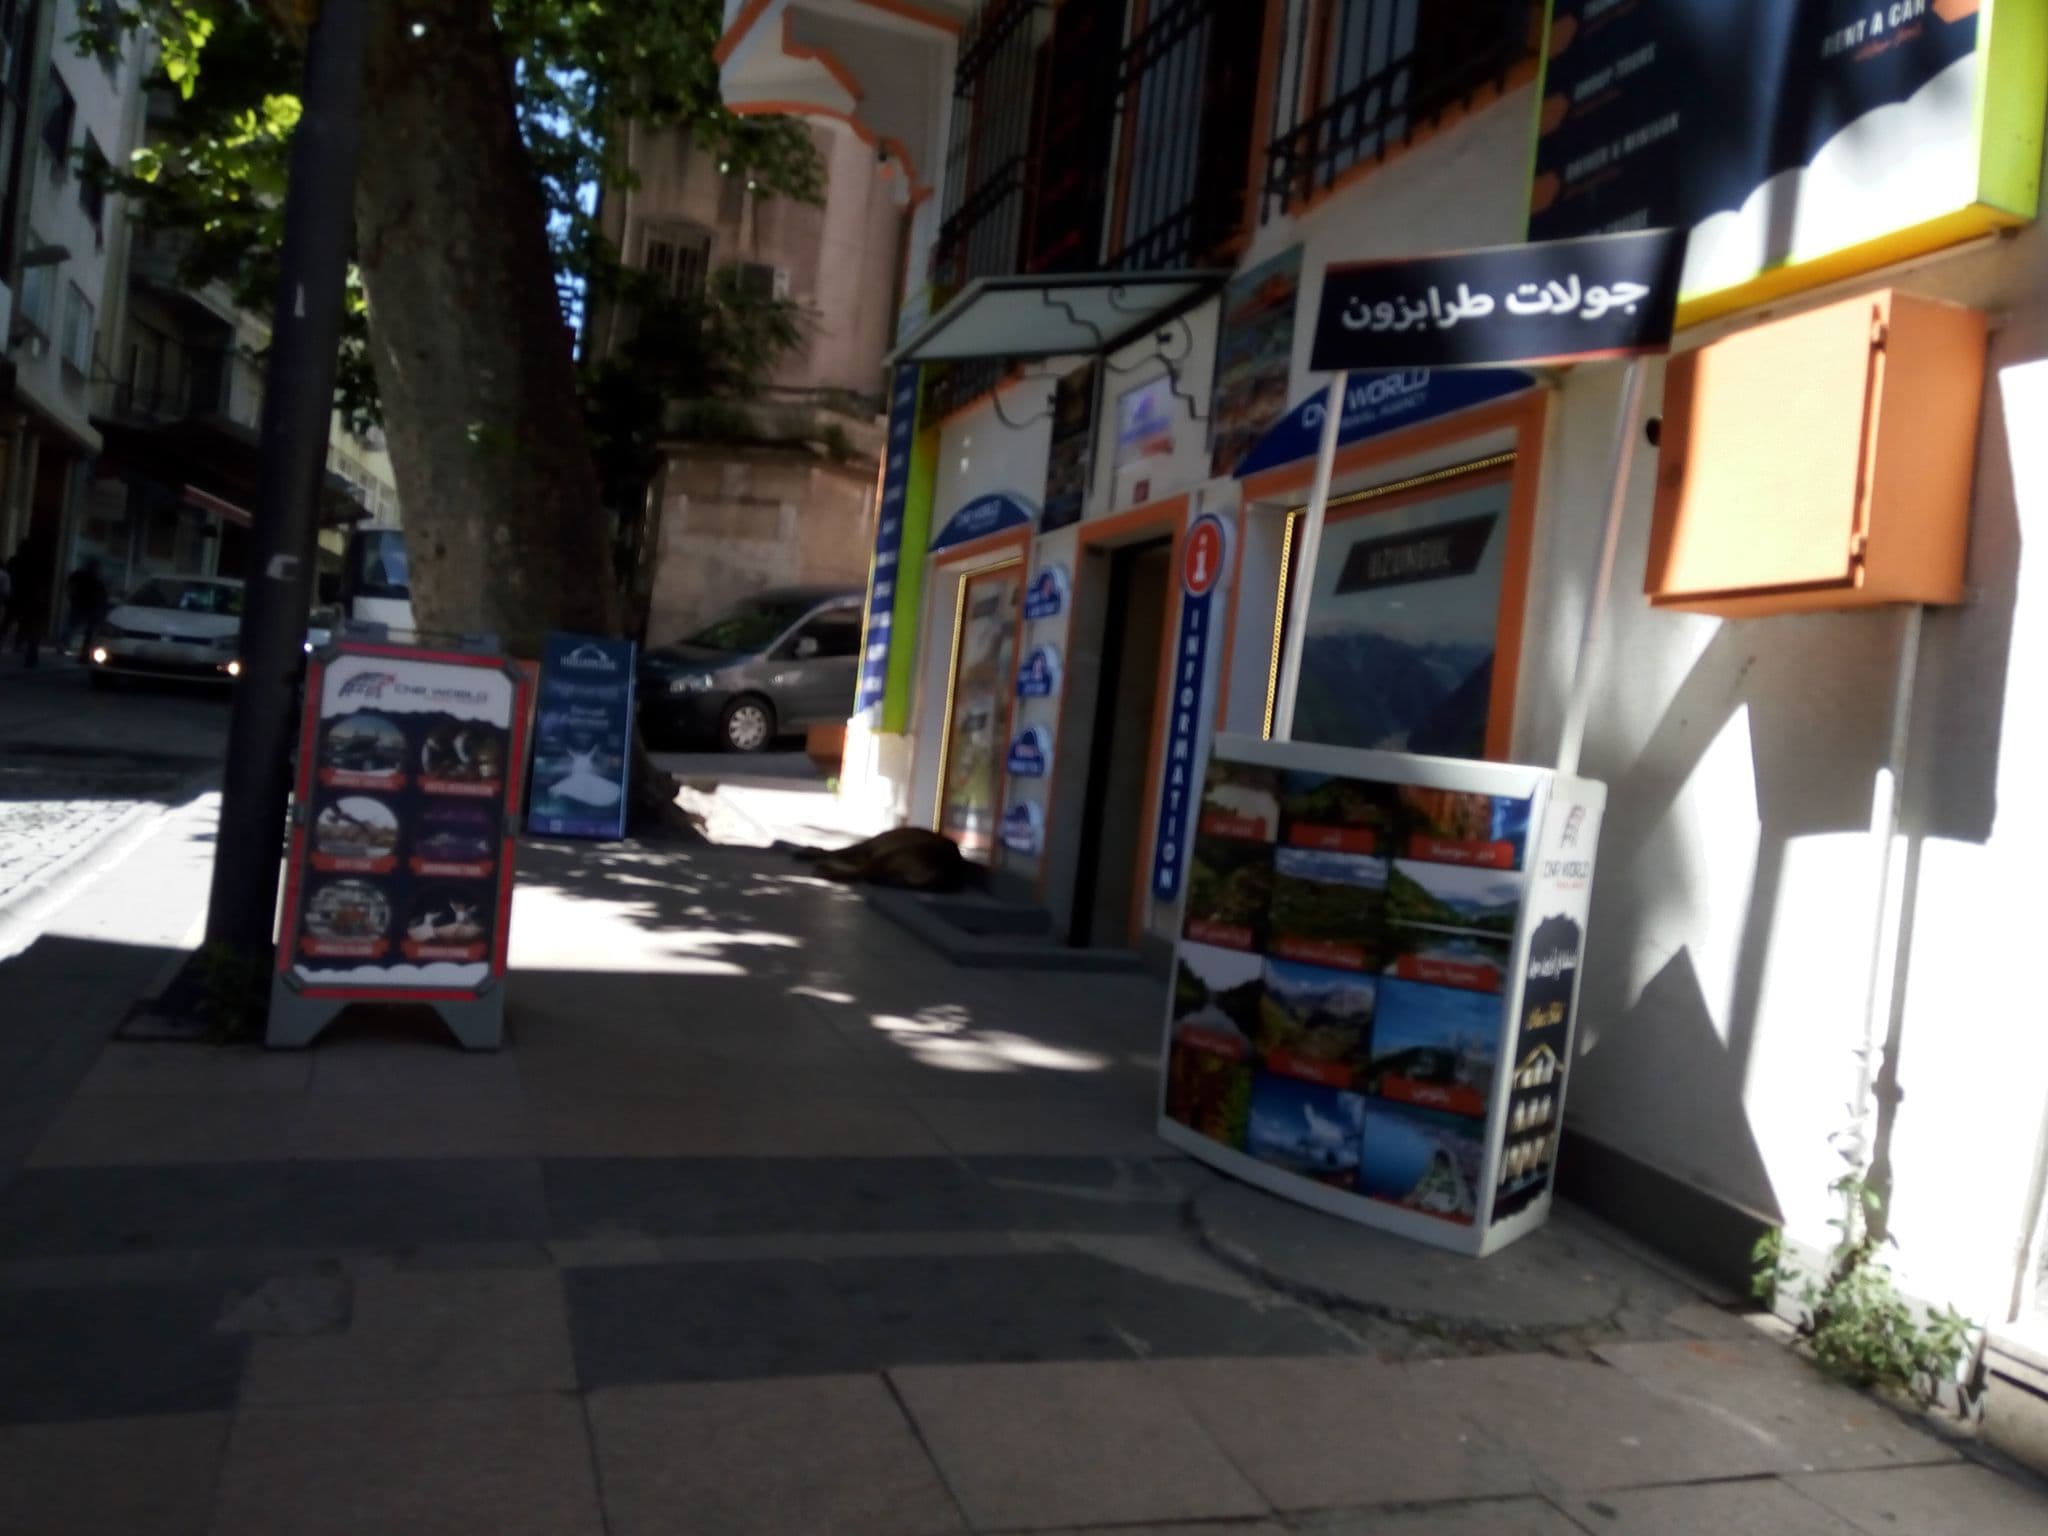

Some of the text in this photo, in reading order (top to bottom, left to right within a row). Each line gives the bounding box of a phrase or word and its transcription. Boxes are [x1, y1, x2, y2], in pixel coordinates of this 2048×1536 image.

[1821, 18, 1867, 57] RENT
[1869, 11, 1884, 36] A
[1887, 0, 1927, 28] CAR
[1341, 273, 1650, 330] جولات طرابزون
[1302, 368, 1430, 429] ON WORLD
[1158, 608, 1200, 890] INFORMATION
